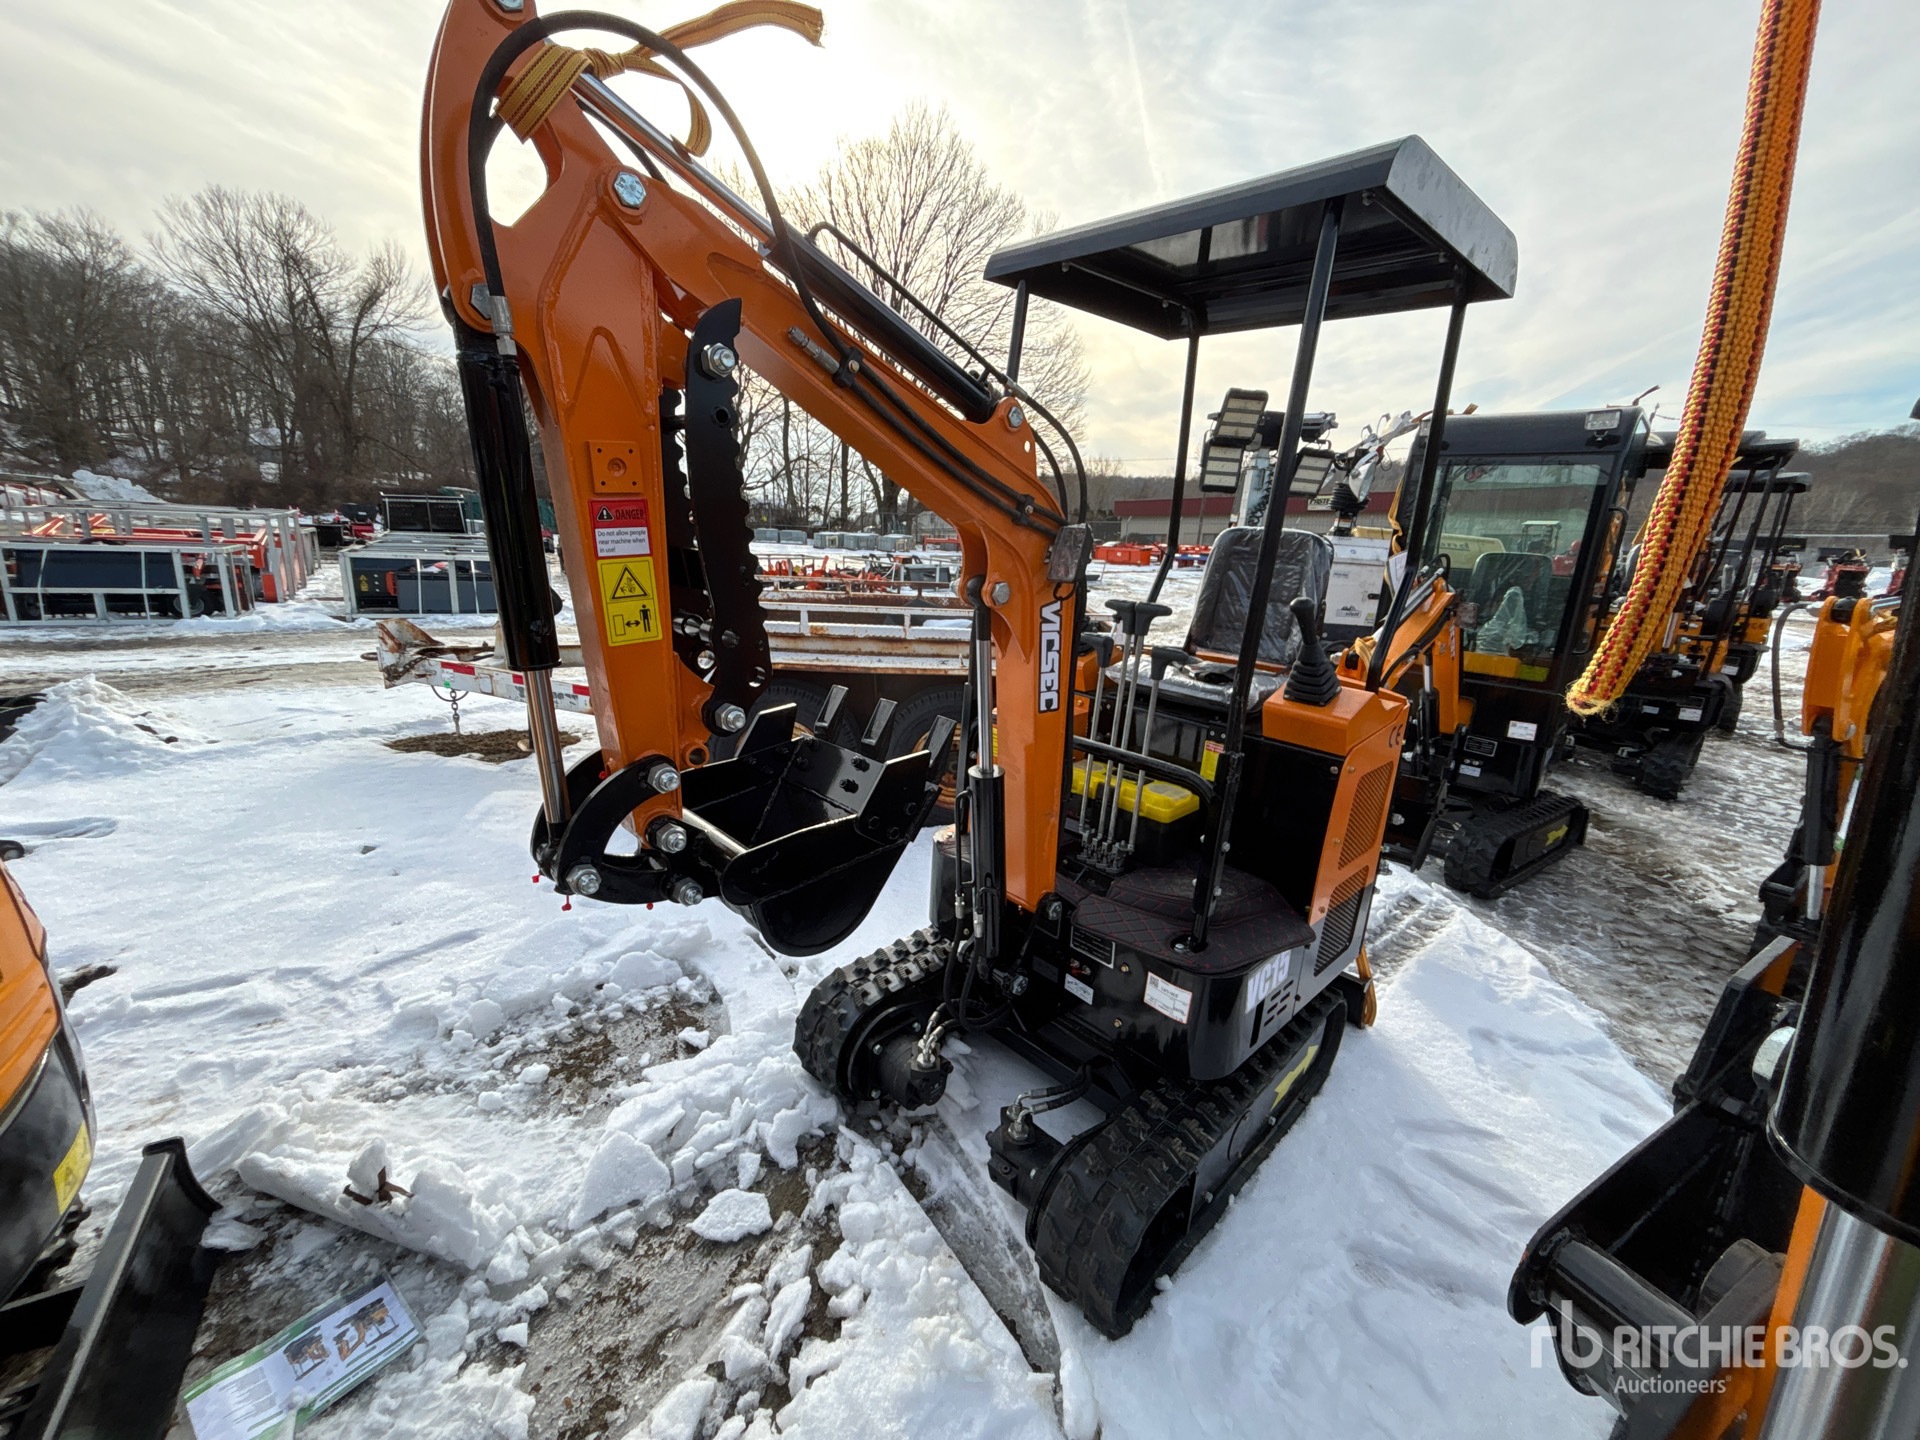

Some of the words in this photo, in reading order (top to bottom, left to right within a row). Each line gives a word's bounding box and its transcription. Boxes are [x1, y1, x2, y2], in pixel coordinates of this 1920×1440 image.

[615, 509, 644, 520] DANGER
[630, 529, 646, 537] people
[1040, 599, 1062, 713] VICSEC
[1246, 951, 1291, 1010] VC15
